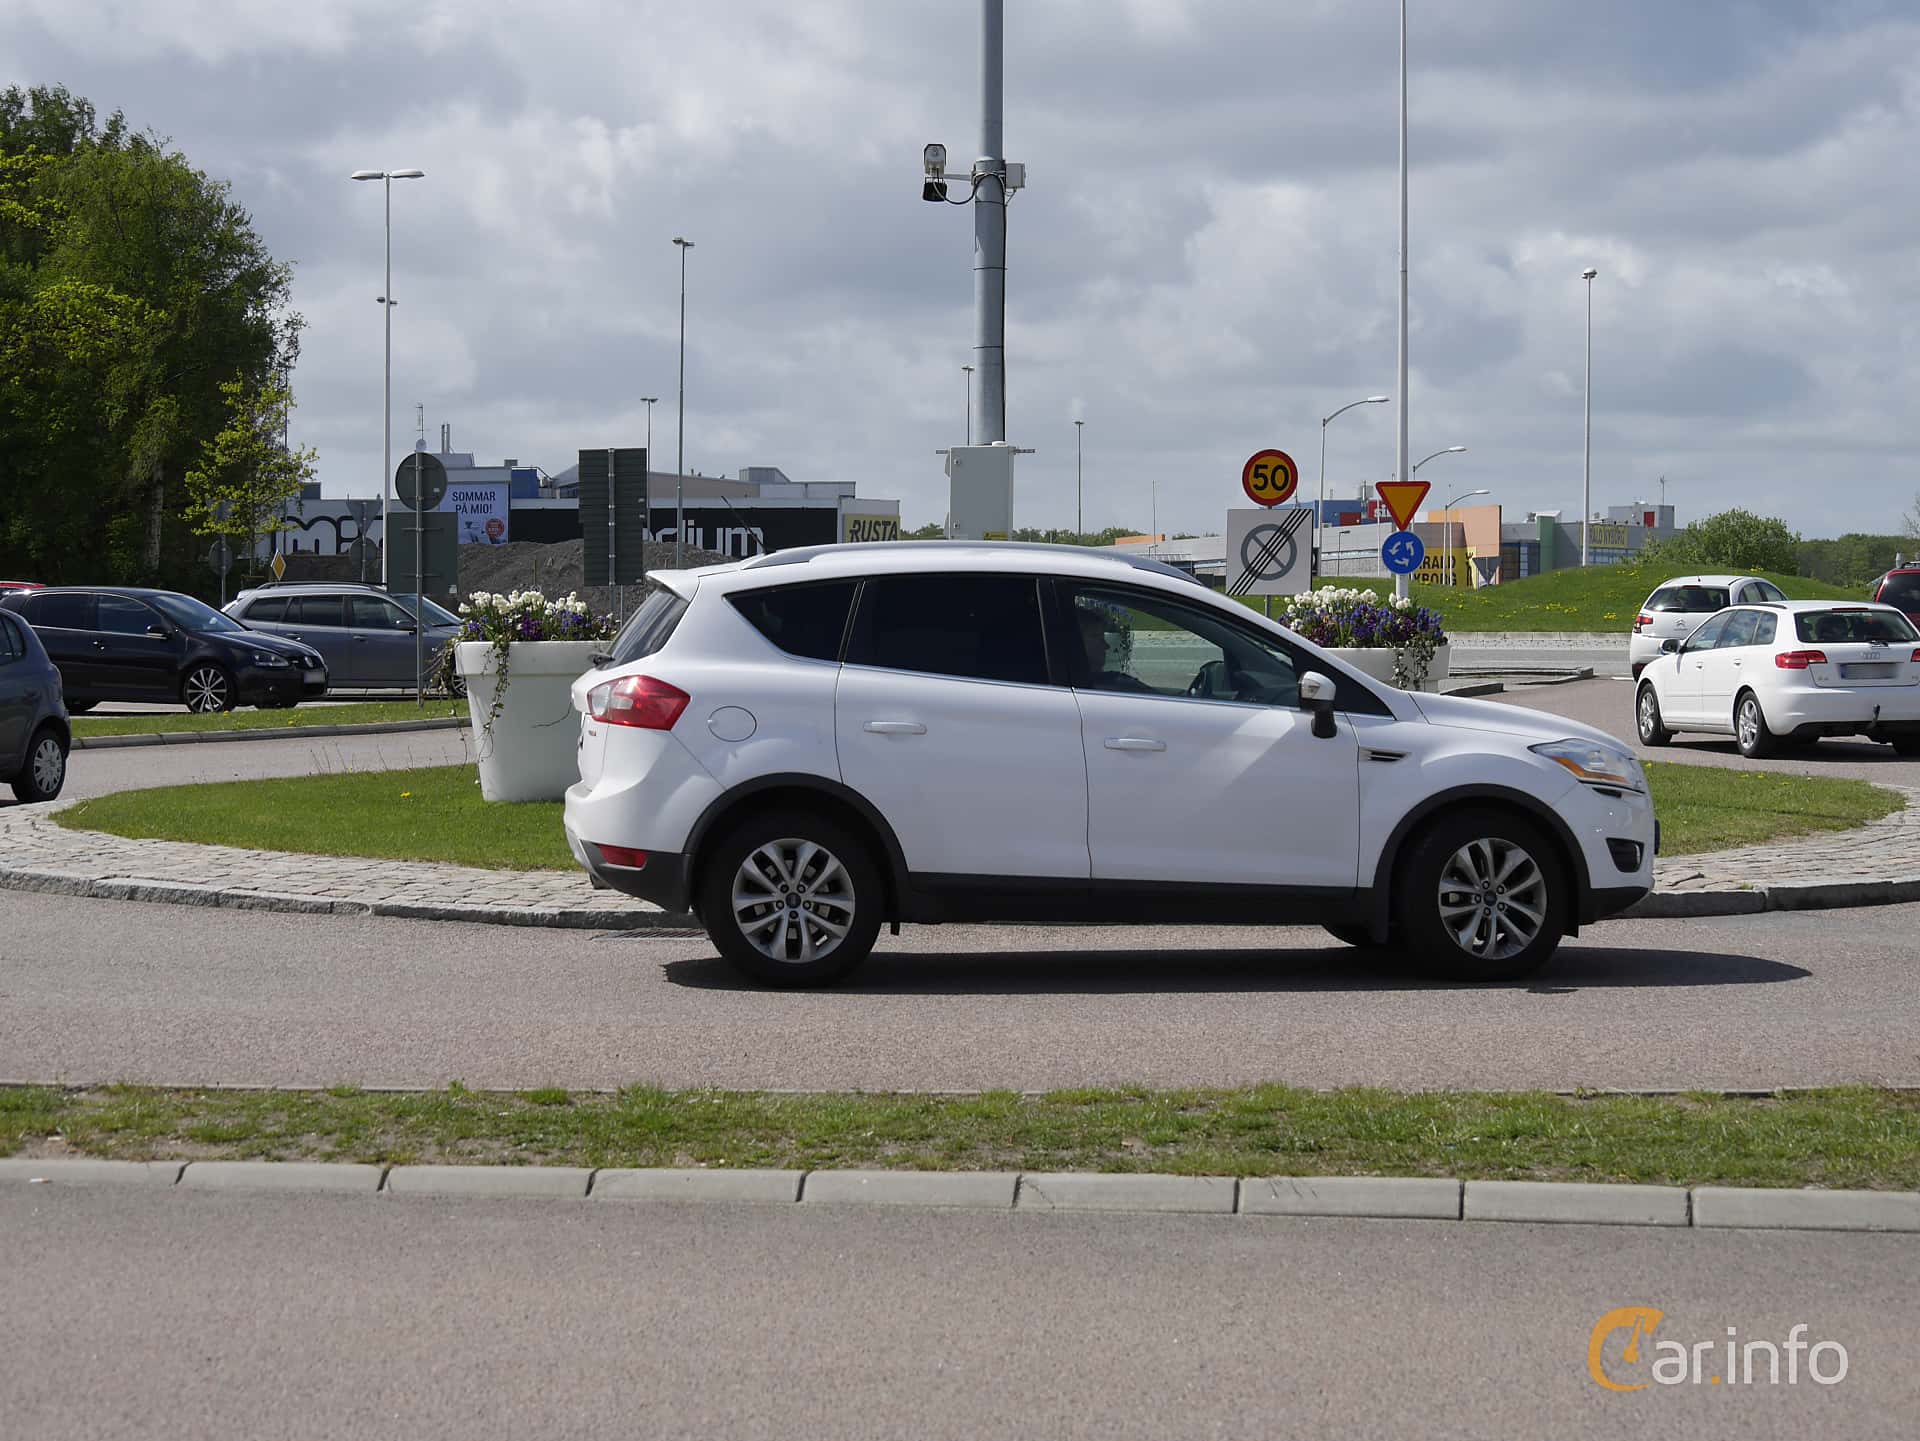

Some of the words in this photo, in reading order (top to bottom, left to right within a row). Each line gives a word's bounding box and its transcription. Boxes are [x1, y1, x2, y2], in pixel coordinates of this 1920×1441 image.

[1253, 464, 1289, 491] 50
[452, 491, 496, 502] SOMMAR
[456, 502, 468, 514] PÅ
[470, 503, 493, 514] MIO!
[642, 520, 764, 557] dium
[849, 520, 898, 543] RUSTA
[1419, 555, 1456, 570] RALD
